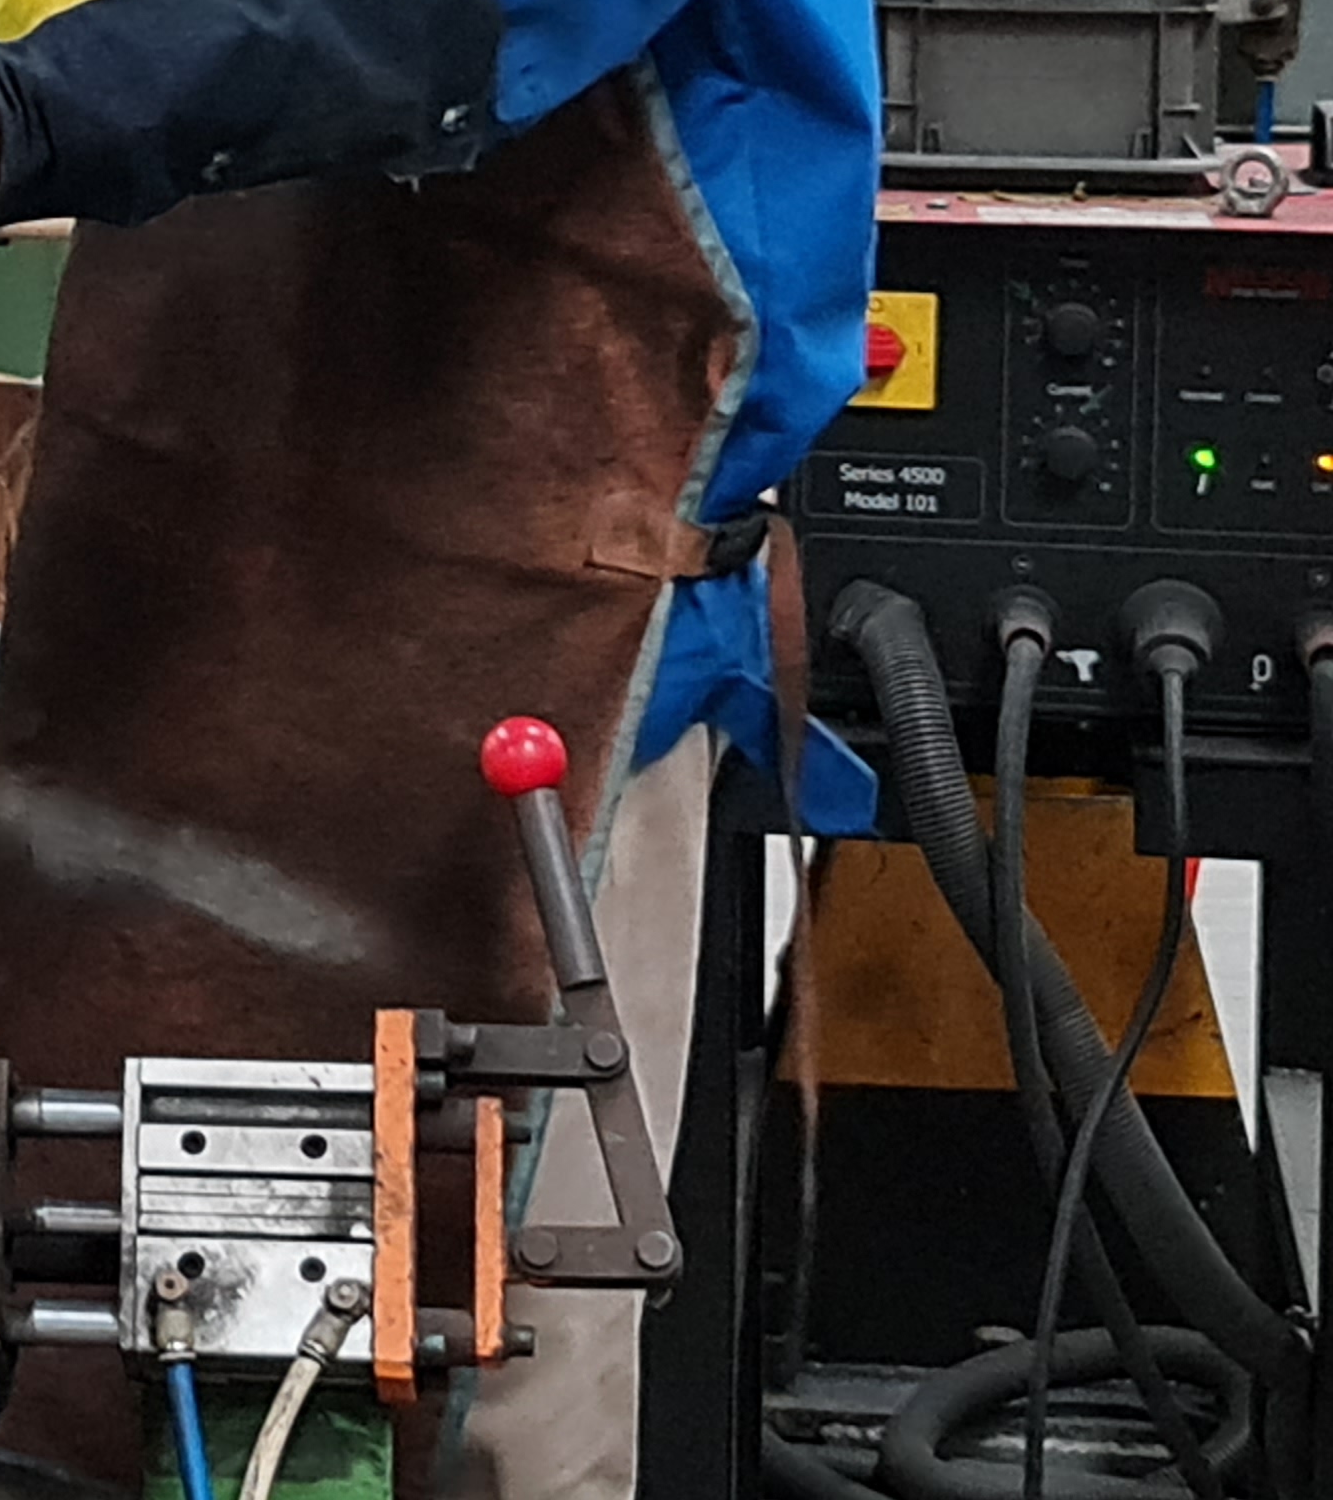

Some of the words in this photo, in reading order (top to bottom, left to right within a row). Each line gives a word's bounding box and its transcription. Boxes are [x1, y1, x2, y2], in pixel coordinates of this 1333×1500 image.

[838, 463, 895, 483] Series
[898, 466, 946, 485] 4500
[844, 491, 900, 509] Model
[905, 494, 939, 513] 101
